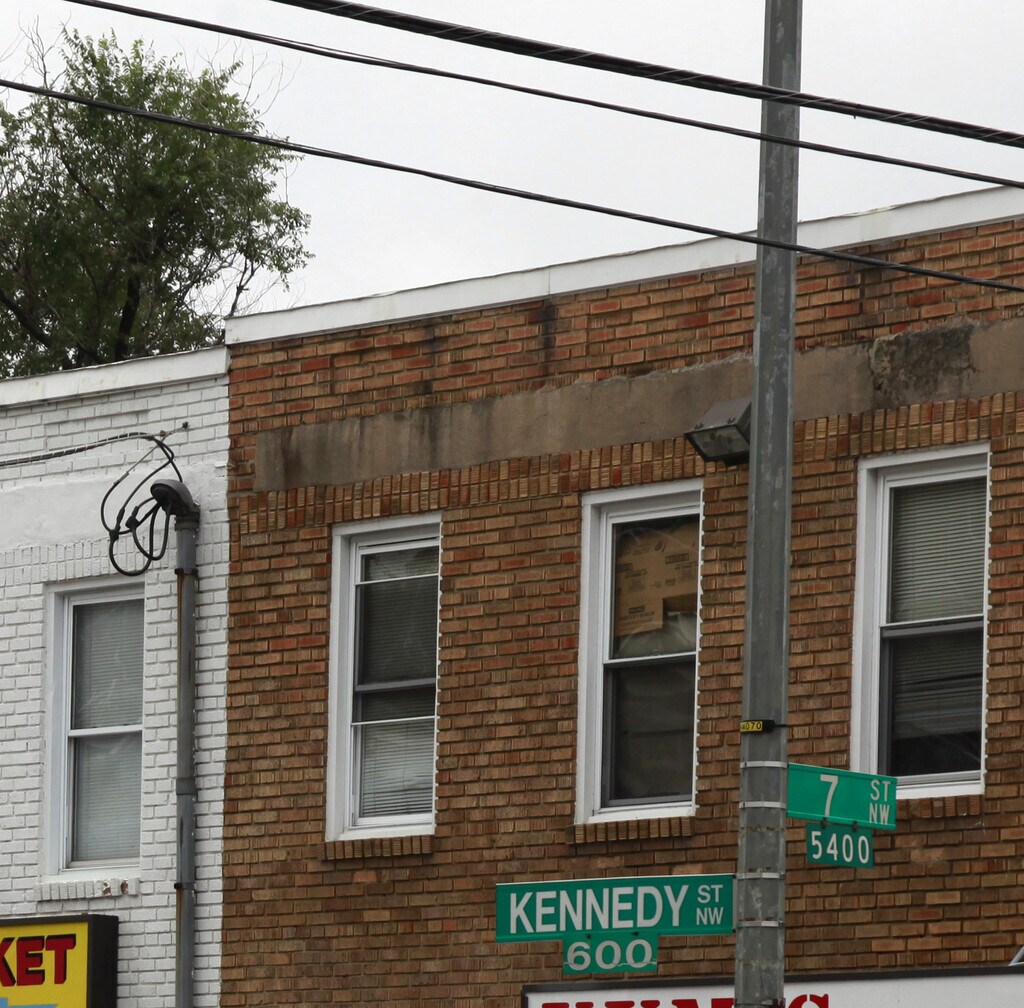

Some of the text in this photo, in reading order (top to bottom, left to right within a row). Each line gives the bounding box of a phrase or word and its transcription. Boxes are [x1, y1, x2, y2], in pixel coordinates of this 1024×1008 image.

[819, 774, 891, 826] 7 ST NW
[811, 830, 870, 864] 5400
[509, 884, 724, 934] KENNEDY ST NW
[567, 938, 653, 971] 600
